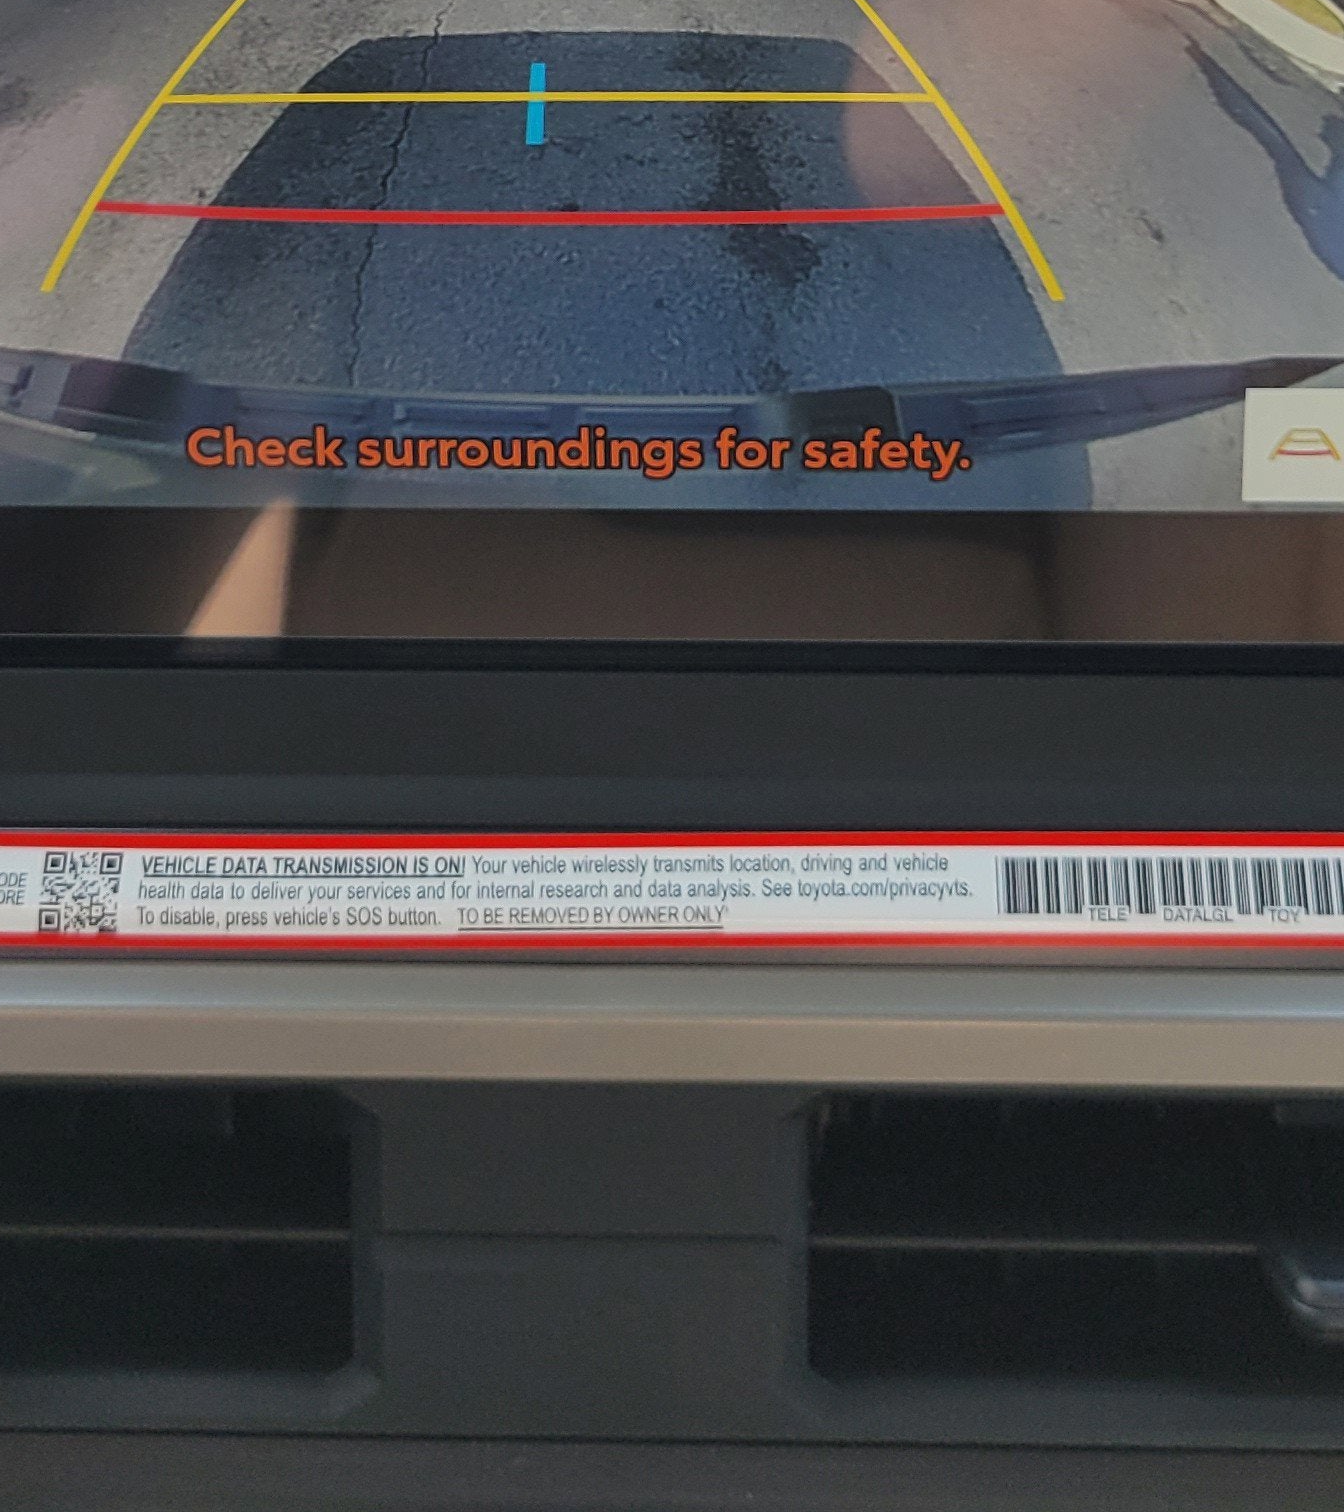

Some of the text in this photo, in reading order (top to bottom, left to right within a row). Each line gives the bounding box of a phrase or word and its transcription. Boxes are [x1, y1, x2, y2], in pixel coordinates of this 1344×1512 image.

[185, 424, 972, 481] Check surroundings for safety.
[142, 855, 217, 874] VEHICLE
[222, 856, 268, 874] DATA
[273, 855, 407, 874] TRANSMISSION
[413, 856, 429, 874] IS
[472, 855, 506, 874] Your
[512, 854, 566, 873] vehicle
[572, 854, 648, 877] wirelessly
[654, 854, 725, 872] transmits
[730, 853, 795, 874] location,
[801, 853, 852, 875] driving
[859, 853, 887, 872] and
[894, 852, 949, 871] vehicle
[138, 880, 185, 899] health
[191, 880, 224, 899] data
[231, 882, 245, 899] to
[251, 881, 301, 899] deliver
[307, 885, 340, 903] your
[348, 881, 411, 899] services
[416, 881, 445, 899] and
[451, 880, 472, 899] for
[477, 880, 534, 899] internal
[540, 879, 607, 899] research
[613, 879, 642, 898] and
[649, 879, 682, 898] data
[687, 878, 756, 901] analysis.
[762, 878, 792, 897] See
[136, 905, 155, 925] To
[160, 906, 220, 928] disable,
[225, 911, 268, 930] press
[273, 906, 340, 926] vehicle's
[346, 906, 382, 926] SOS
[388, 906, 442, 926] button.
[457, 906, 479, 924] TO
[483, 906, 504, 924] BE
[509, 906, 589, 924] REMOVED
[593, 906, 615, 924] BY
[618, 905, 679, 924] OWNER
[1088, 907, 1128, 922] TELE
[1269, 907, 1300, 923] TOY
